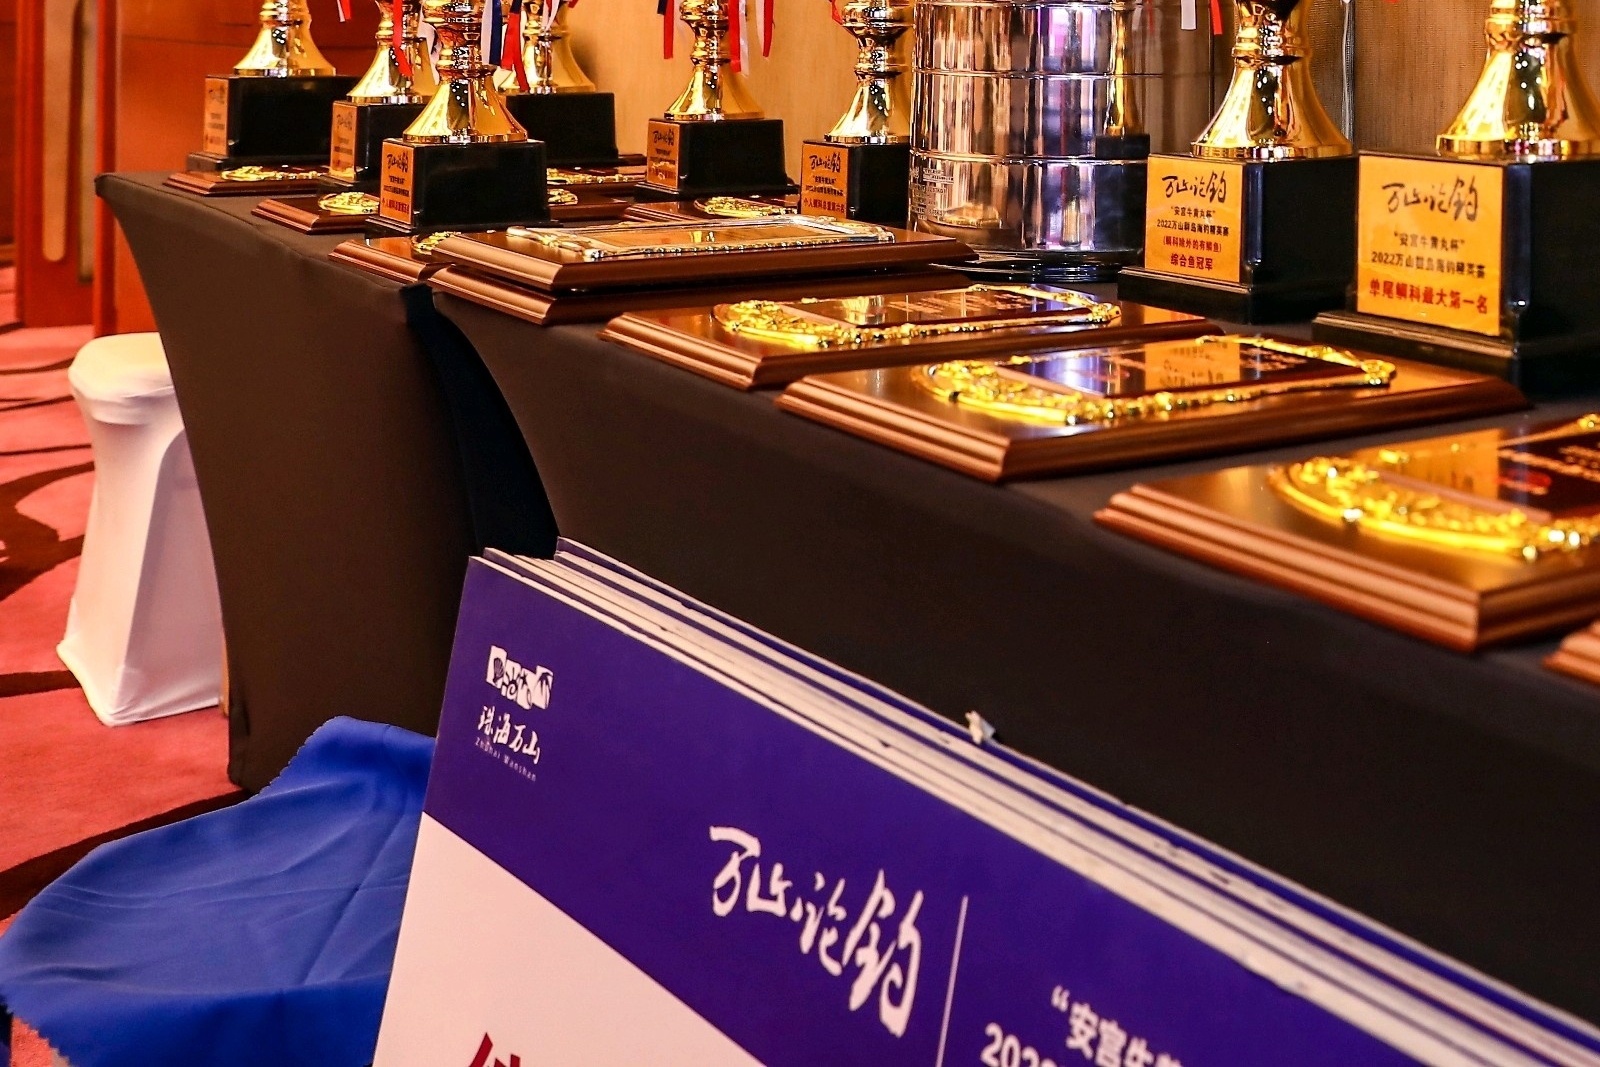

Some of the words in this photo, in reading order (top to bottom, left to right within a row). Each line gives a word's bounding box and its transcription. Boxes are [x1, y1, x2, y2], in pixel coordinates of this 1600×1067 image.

[1170, 253, 1213, 271] 综合鱼冠军
[477, 705, 541, 765] 珠海万山
